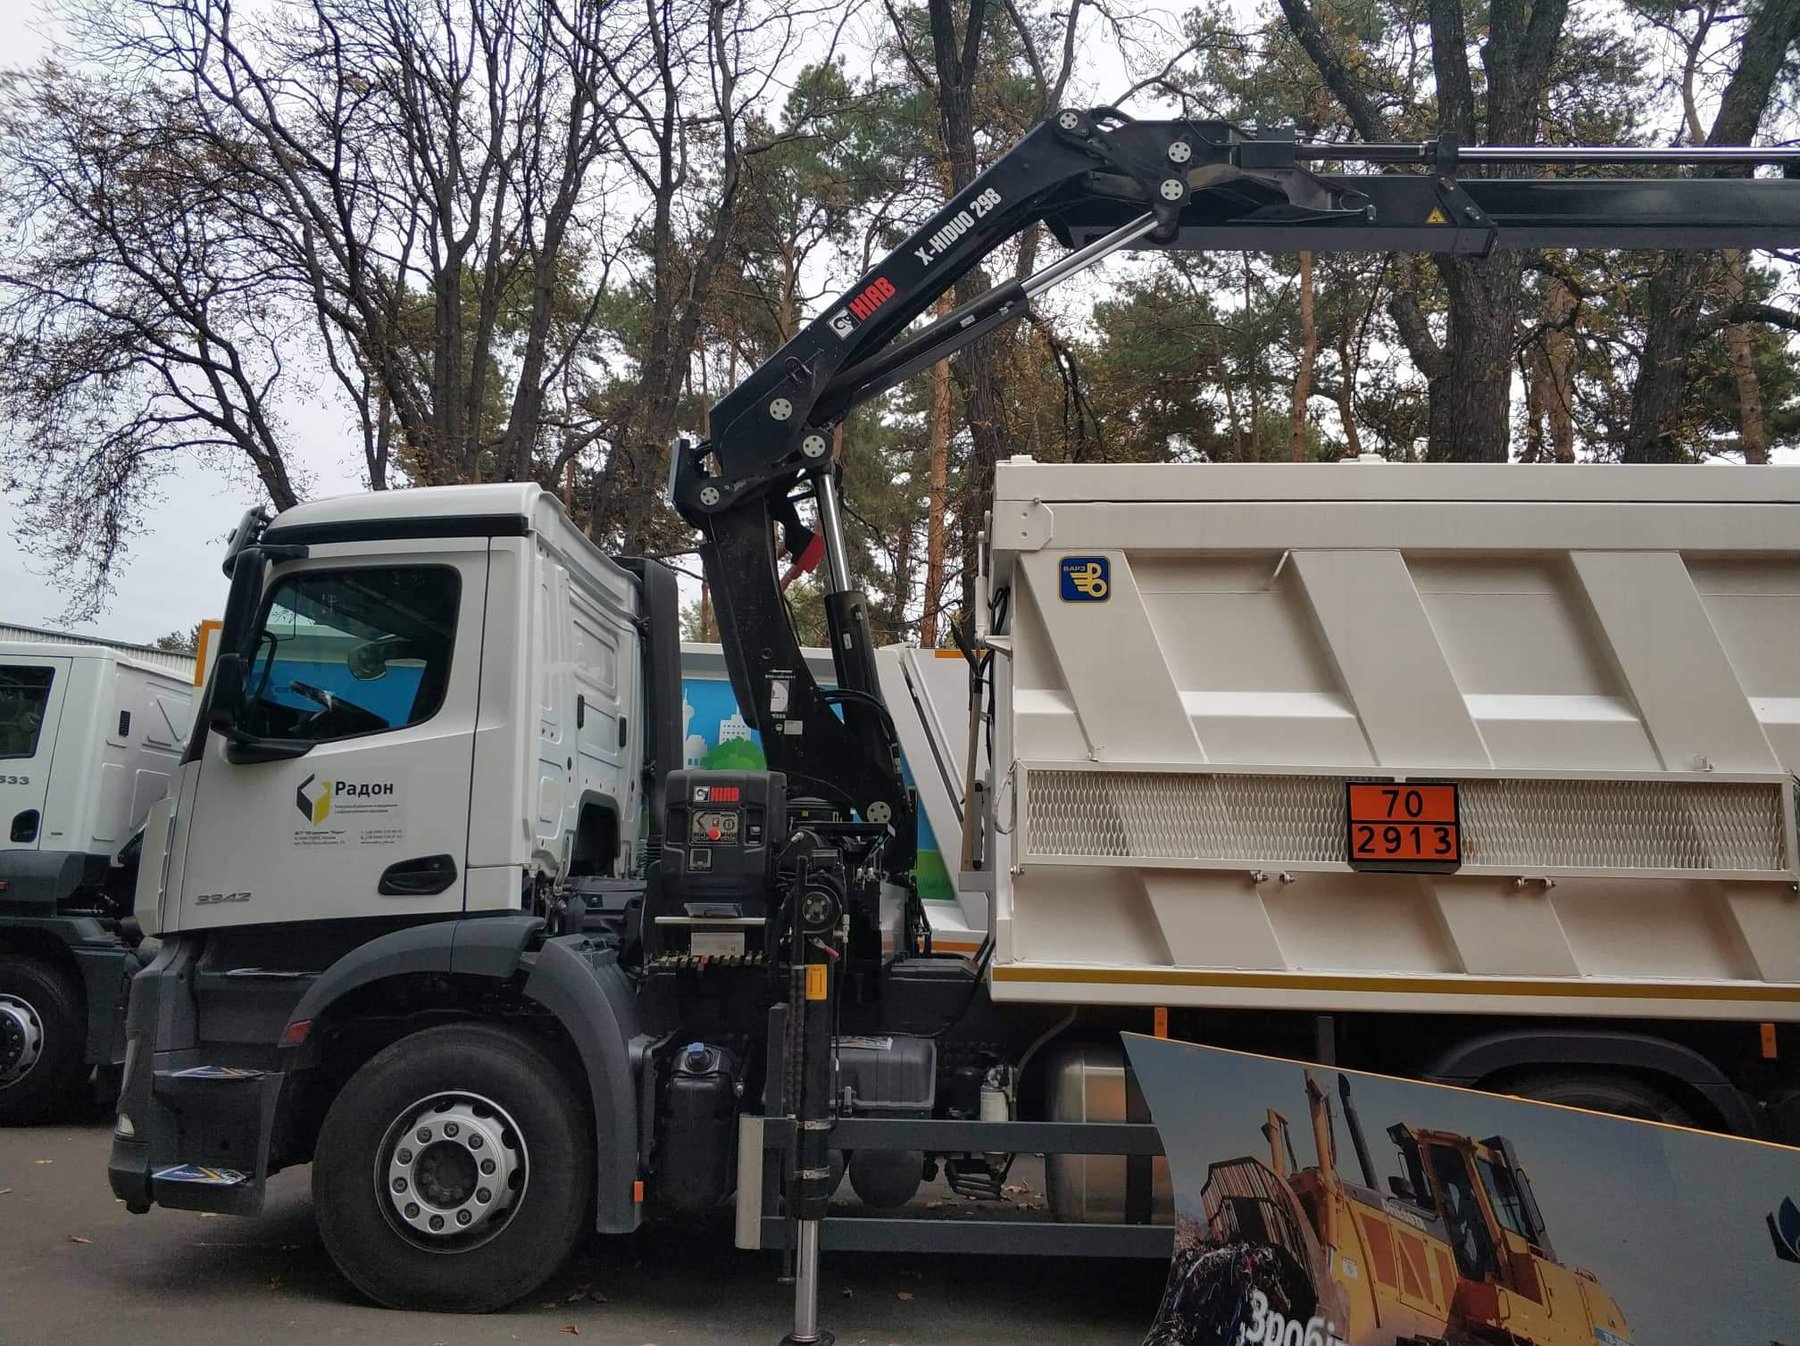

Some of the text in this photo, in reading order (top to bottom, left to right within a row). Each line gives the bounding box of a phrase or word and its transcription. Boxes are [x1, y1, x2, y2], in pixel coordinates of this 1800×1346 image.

[914, 187, 1002, 266] X-HIDUO 298
[848, 275, 897, 321] HIAB
[335, 781, 394, 798] Радон
[1381, 789, 1423, 818] 70
[1357, 825, 1452, 855] 2913
